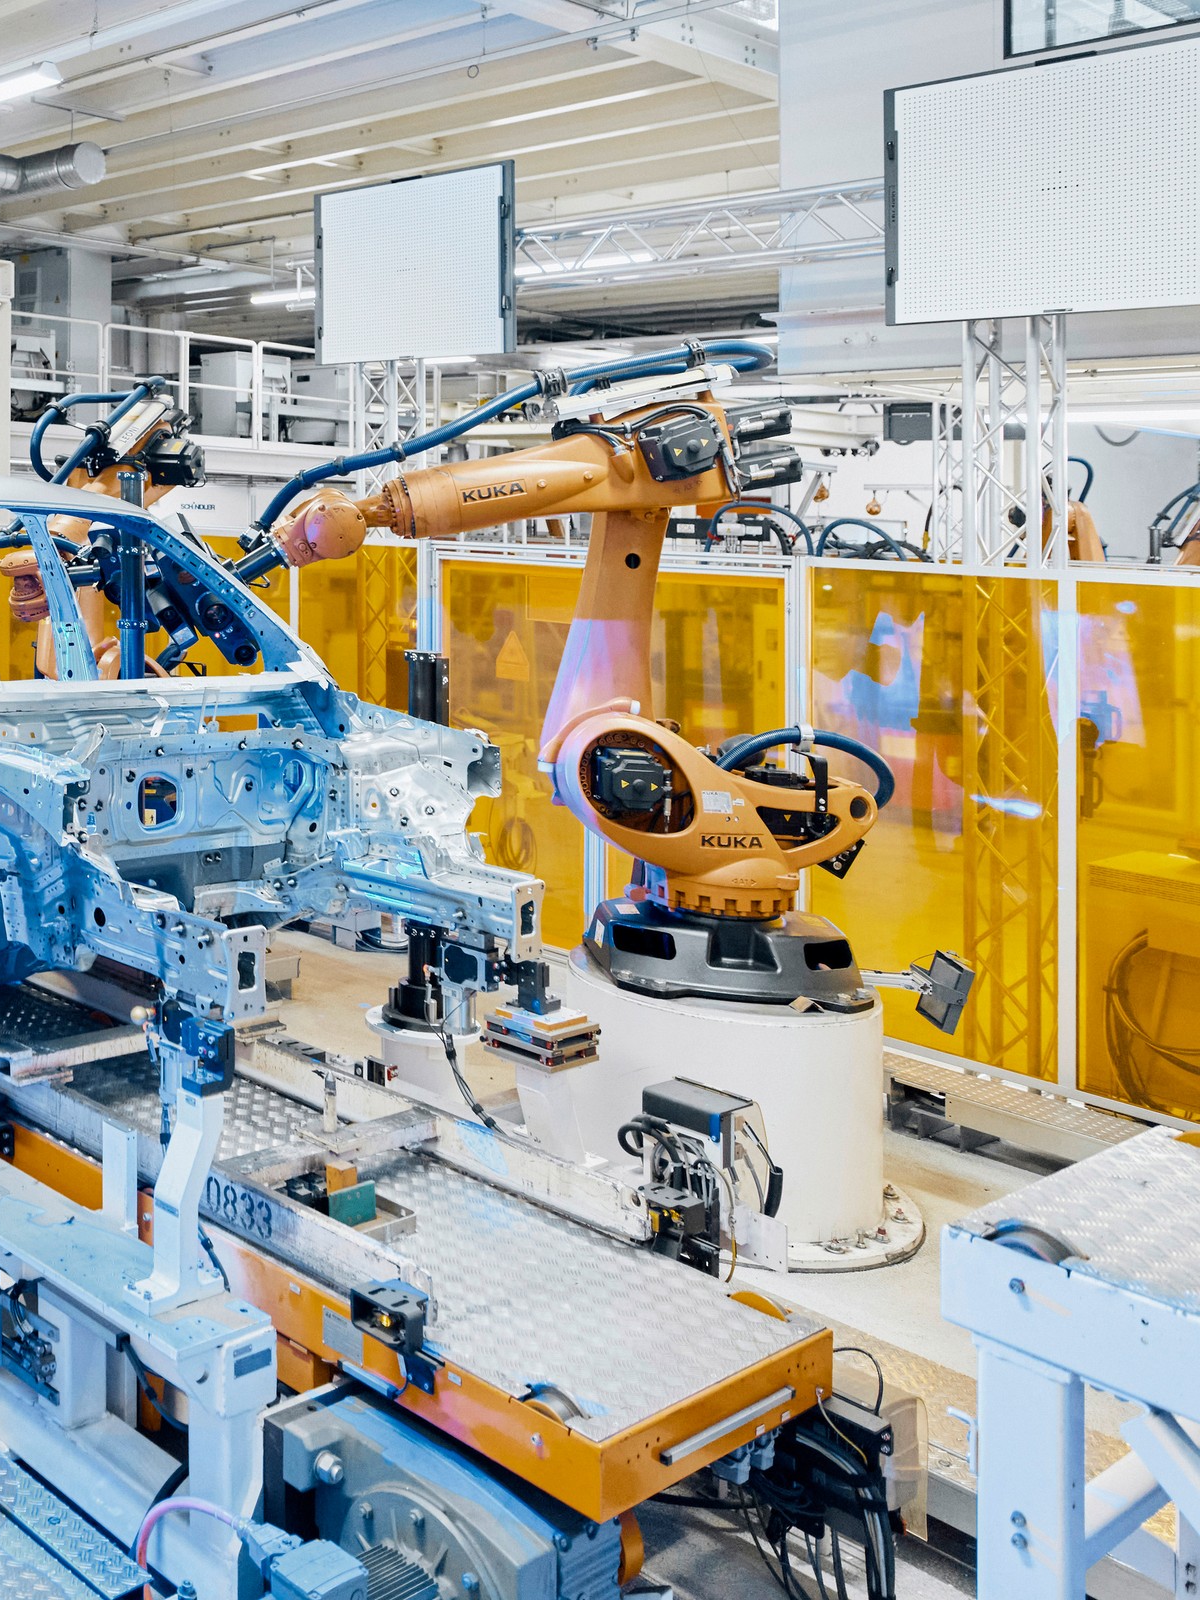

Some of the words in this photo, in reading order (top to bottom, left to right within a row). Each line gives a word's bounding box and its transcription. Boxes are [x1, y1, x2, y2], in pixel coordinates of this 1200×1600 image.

[118, 425, 141, 444] LEONI
[462, 481, 525, 503] KUKA
[701, 835, 763, 849] KUKA
[206, 1176, 273, 1239] 0833
